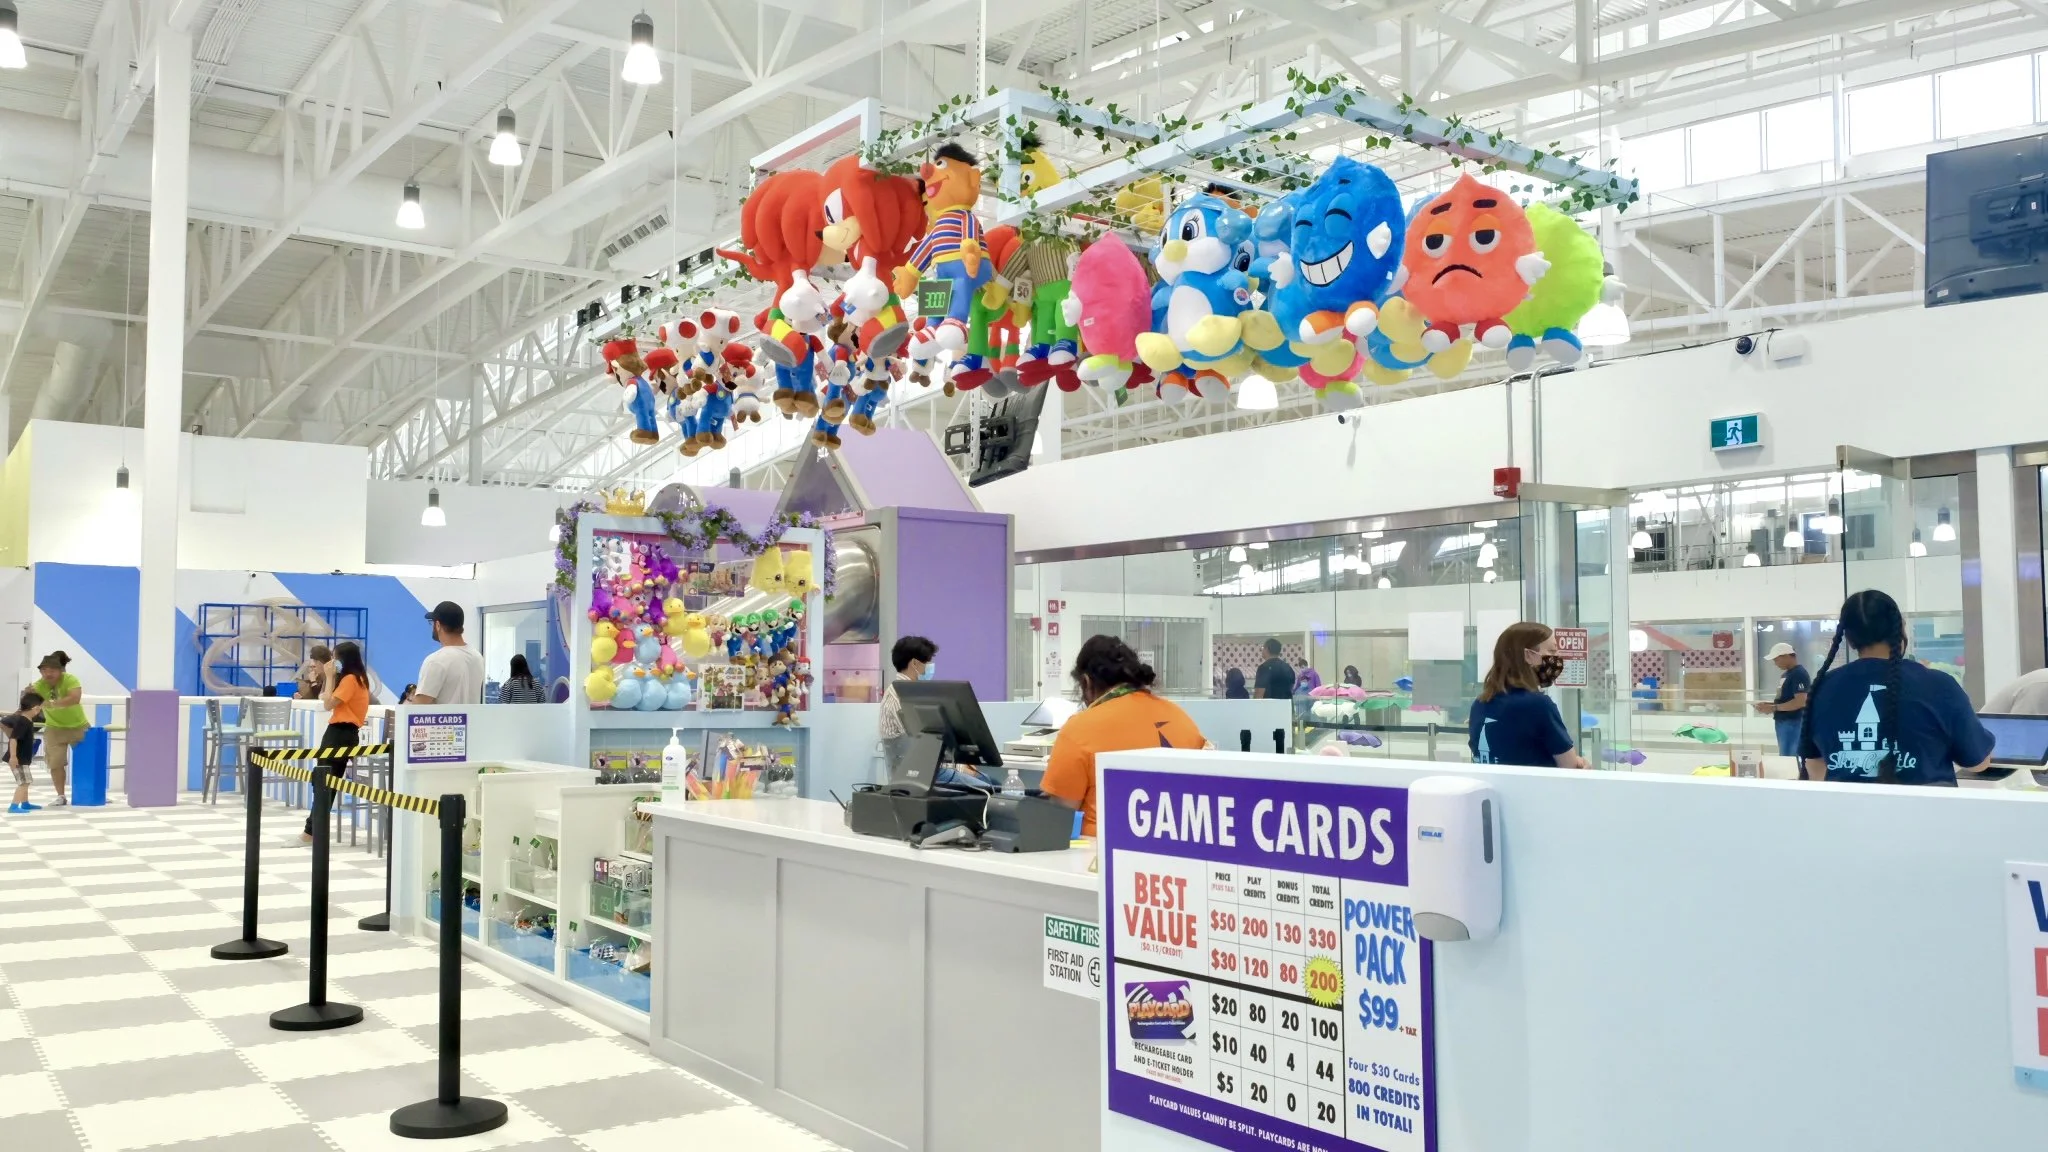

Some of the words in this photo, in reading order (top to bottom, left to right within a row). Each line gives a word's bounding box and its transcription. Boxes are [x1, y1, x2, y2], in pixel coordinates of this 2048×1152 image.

[1559, 636, 1584, 650] OPEN
[413, 716, 437, 724] GAME
[438, 716, 463, 724] CARDS
[1127, 788, 1236, 847] GAME
[1252, 798, 1395, 867] CARDS
[1215, 872, 1231, 882] PRICE
[1247, 876, 1262, 886] PLAY
[1277, 880, 1298, 891] BONUS
[1312, 884, 1331, 896] TOTAL
[1134, 872, 1187, 911] BEST
[1243, 888, 1266, 900] CREDITS
[1276, 893, 1300, 905] CREDITS
[1309, 898, 1334, 910] CREDITS
[1047, 919, 1079, 941] SAFETY
[1080, 925, 1100, 946] FIRS
[1123, 904, 1197, 949] VALUE
[1210, 909, 1236, 932] $50
[1242, 916, 1268, 938] 200
[1275, 922, 1301, 944] 130
[1308, 927, 1337, 950] 330
[1344, 898, 1416, 943] POWER
[1047, 947, 1069, 965] FIRST
[1070, 953, 1084, 967] AID
[1211, 948, 1237, 971] $30
[1243, 956, 1269, 978] 120
[1280, 963, 1298, 984] 80
[1310, 970, 1338, 993] 200
[1355, 933, 1406, 985] PACK
[1049, 963, 1081, 983] STATION
[1128, 999, 1191, 1019] PLAYCARD
[1212, 993, 1237, 1016] $20
[1249, 1003, 1266, 1024] 80
[1281, 1010, 1299, 1031] 20
[1311, 1017, 1338, 1041] 100
[1359, 988, 1399, 1031] $99
[1405, 1026, 1417, 1036] TAX
[1133, 1054, 1146, 1065] AND
[1147, 1058, 1171, 1072] E-TICKET
[1171, 1067, 1194, 1079] HOLDER
[1134, 1041, 1176, 1060] RECHARGEABLE
[1177, 1053, 1193, 1064] CARD
[1212, 1031, 1238, 1055] $10
[1250, 1043, 1267, 1064] 40
[1286, 1052, 1295, 1071] 4
[1316, 1060, 1334, 1082] 44
[1348, 1057, 1368, 1073] Four
[1371, 1062, 1390, 1079] $30
[1393, 1068, 1420, 1086] Cards
[1217, 1071, 1234, 1094] $5
[1250, 1082, 1268, 1104] 20
[1287, 1092, 1296, 1112] 0
[1317, 1101, 1336, 1124] 20
[1348, 1078, 1370, 1097] 800
[1374, 1084, 1420, 1111] CREDITS
[1149, 1095, 1178, 1111] PLAYCARD
[1179, 1103, 1201, 1119] VALUES
[1202, 1111, 1227, 1127] CANNOT
[1228, 1119, 1236, 1130] BE
[1237, 1122, 1257, 1137] SPLIT.
[1258, 1128, 1295, 1148] PLAYCARDS
[1297, 1141, 1311, 1152] ARE
[1356, 1103, 1370, 1122] IN
[1373, 1108, 1413, 1134] TOTAL!
